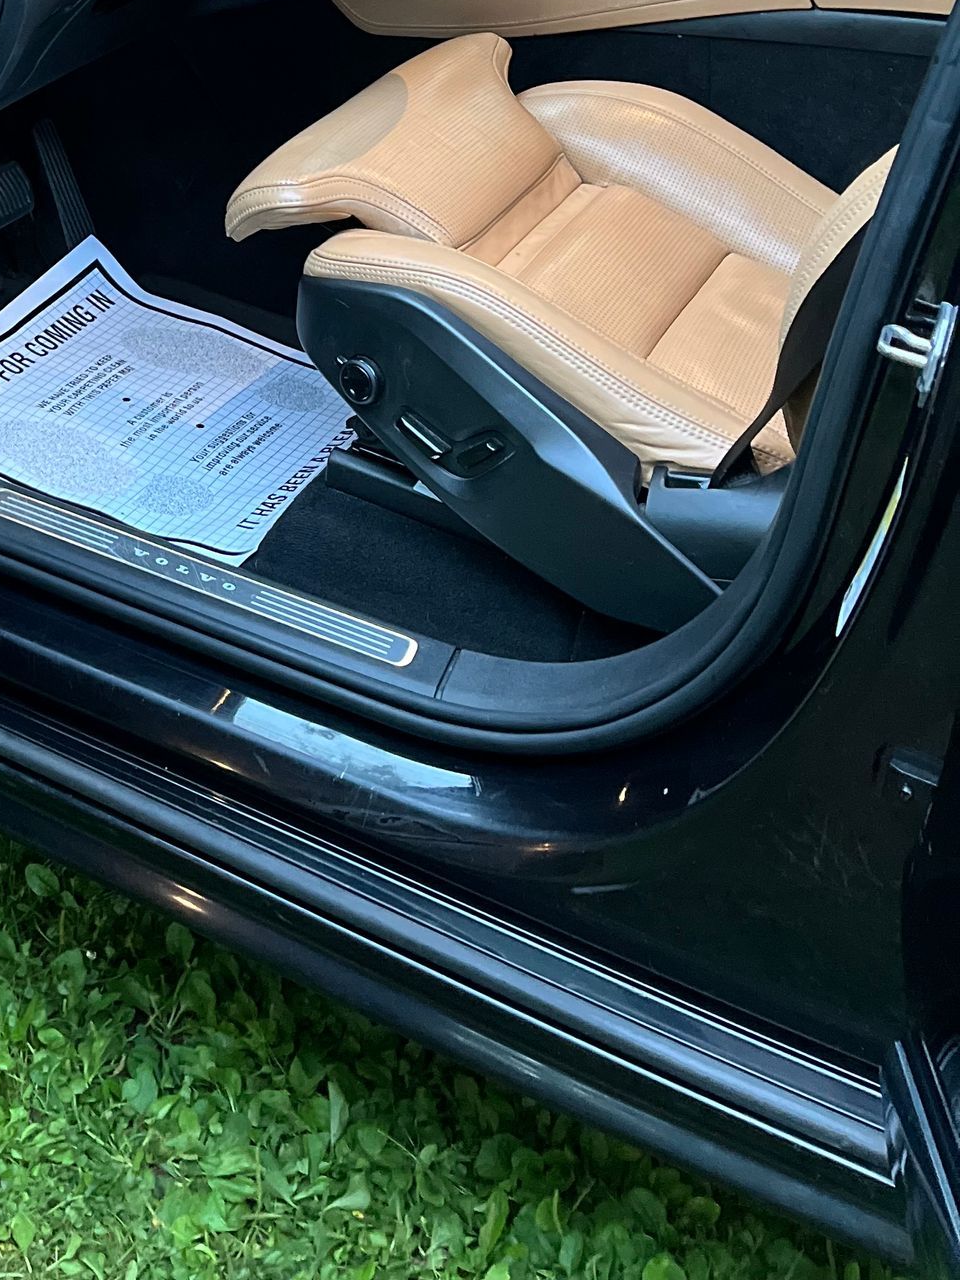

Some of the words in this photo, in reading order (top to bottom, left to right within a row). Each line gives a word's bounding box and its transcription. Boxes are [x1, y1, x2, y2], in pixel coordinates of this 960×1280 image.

[24, 304, 97, 357] COMING
[85, 289, 116, 313] IN
[37, 400, 51, 409] WE
[48, 387, 70, 401] HAVE
[65, 373, 88, 389] TRIED
[85, 366, 98, 374] TO
[96, 354, 113, 367] KEEP
[48, 399, 71, 414] YOUR
[67, 372, 106, 400] CARPETING
[103, 359, 127, 373] CLEAN
[63, 400, 86, 416] WITH
[81, 388, 101, 402] THIS
[97, 374, 121, 391] PAPER
[120, 436, 135, 448] the
[133, 421, 153, 437] most
[147, 398, 184, 424] important
[180, 382, 205, 400] person
[133, 397, 165, 420] customer
[147, 433, 158, 441] in
[153, 424, 169, 434] the
[166, 409, 187, 425] world
[189, 448, 211, 463] Your
[207, 419, 247, 449] suggestions
[241, 412, 256, 421] for
[202, 441, 240, 471] improving
[235, 433, 248, 443] our
[246, 415, 272, 434] service
[219, 463, 234, 476] are
[230, 444, 256, 464] always
[236, 518, 260, 530] IT
[251, 493, 288, 516] HAS
[277, 465, 319, 493] BEEN
[310, 455, 328, 463] A
[133, 547, 237, 592] VOLVO
